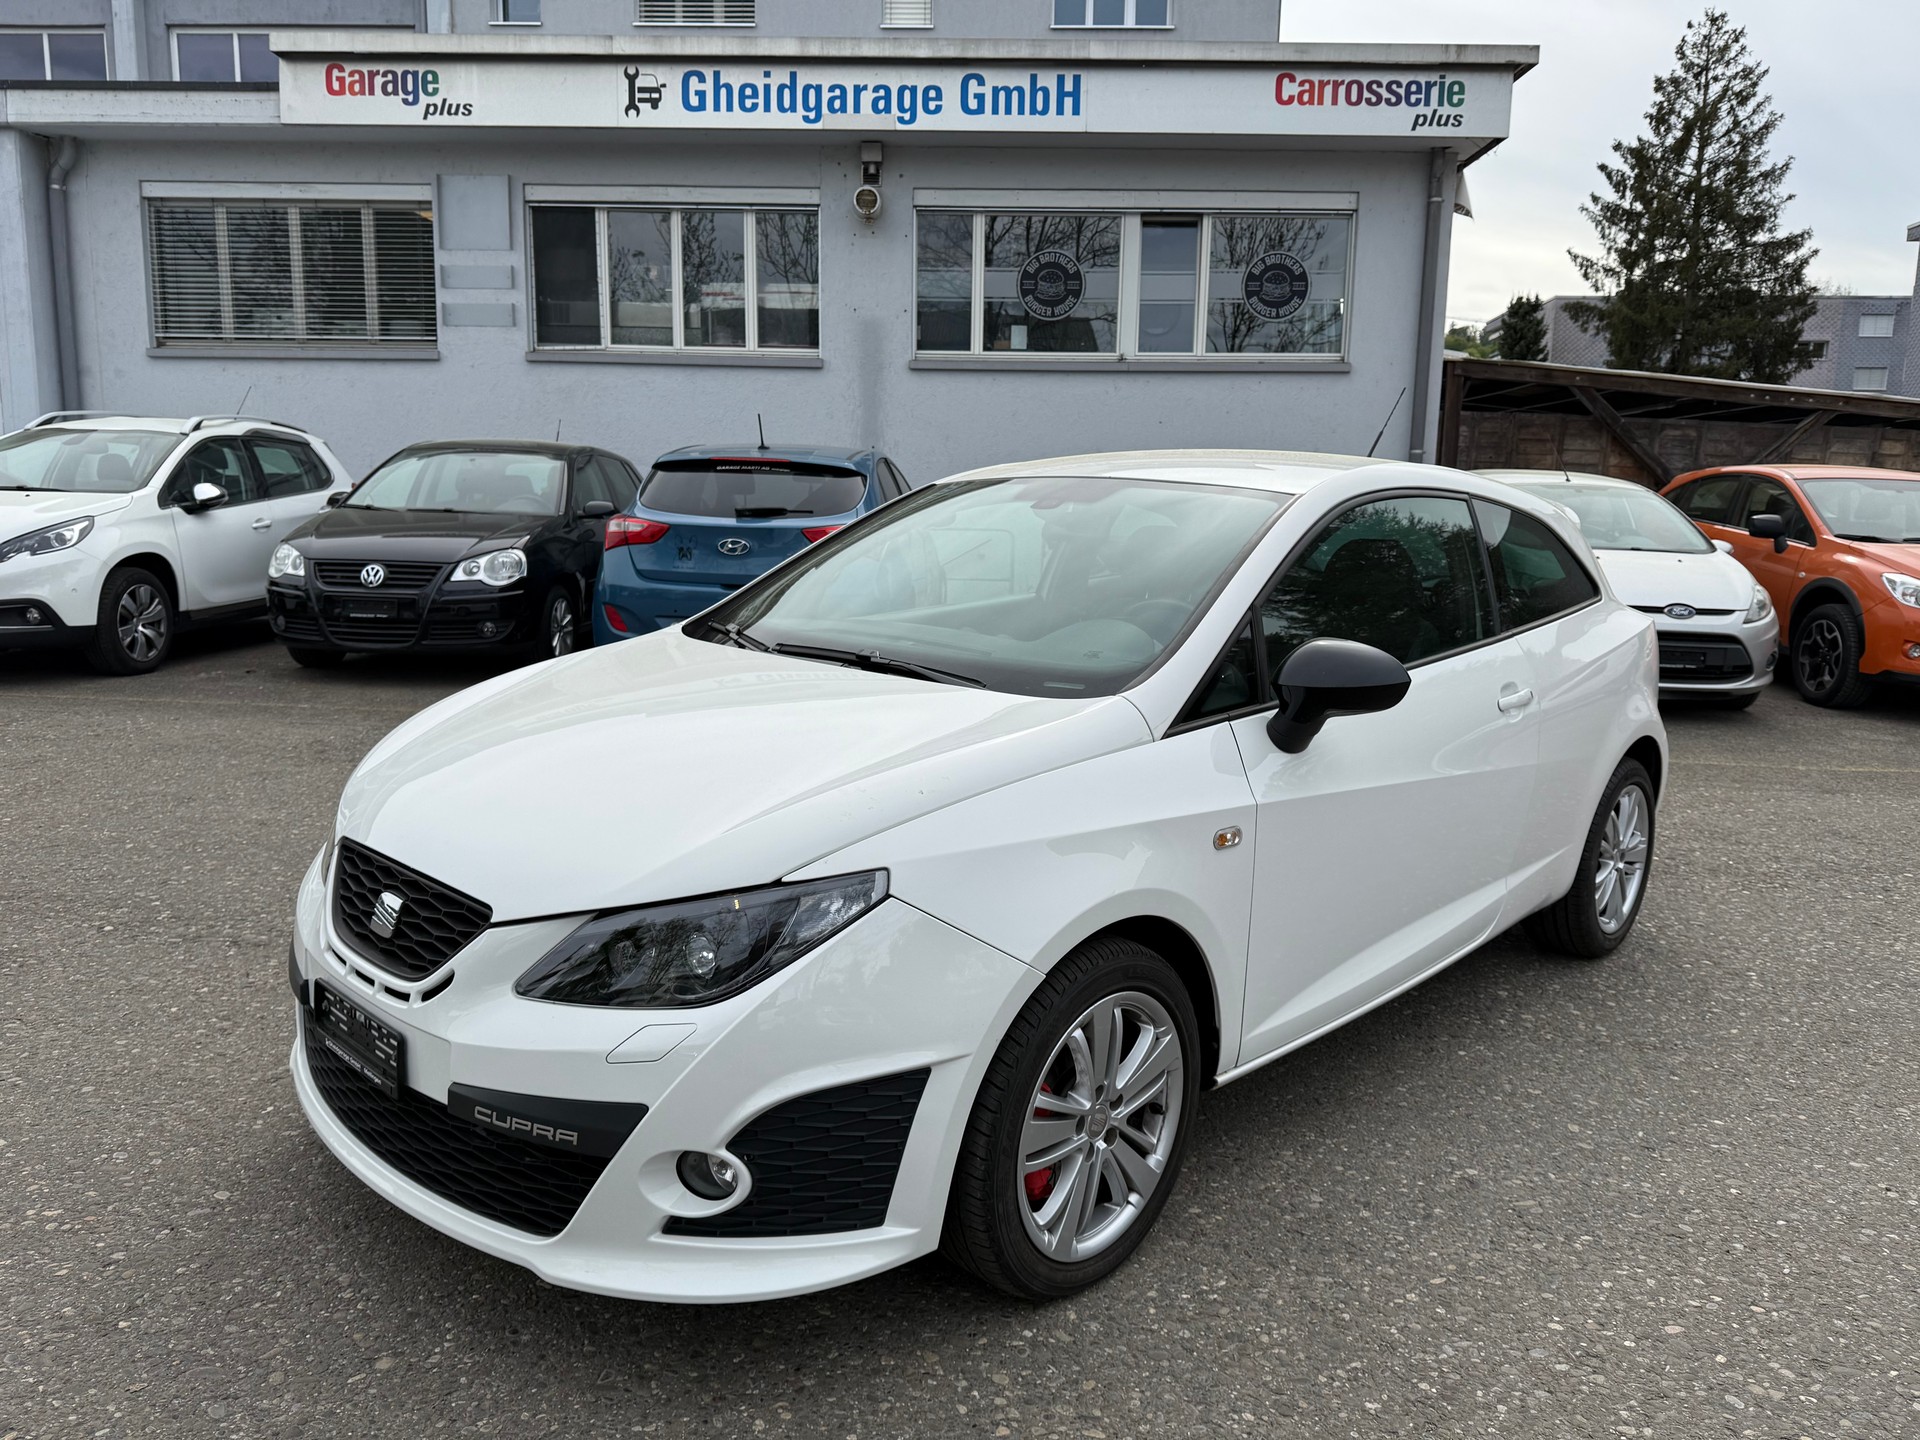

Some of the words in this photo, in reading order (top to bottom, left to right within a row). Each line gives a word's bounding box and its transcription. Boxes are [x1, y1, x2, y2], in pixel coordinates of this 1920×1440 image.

[325, 62, 440, 107] Garage
[1275, 71, 1466, 107] Carrosserie
[681, 69, 943, 125] Gheidgarage
[960, 73, 1082, 117] GmbH
[422, 98, 474, 120] plus
[1410, 109, 1464, 132] plus
[1025, 259, 1040, 274] BIG
[1038, 252, 1078, 274] BROTHERS
[1250, 260, 1266, 276] BIG
[1264, 254, 1304, 276] BROTHERS
[1024, 294, 1052, 317] BURGER
[1053, 294, 1078, 316] HOUSE
[1248, 296, 1277, 318] BURGER
[1278, 295, 1303, 317] HOUSE
[474, 1105, 579, 1146] CUPRA
